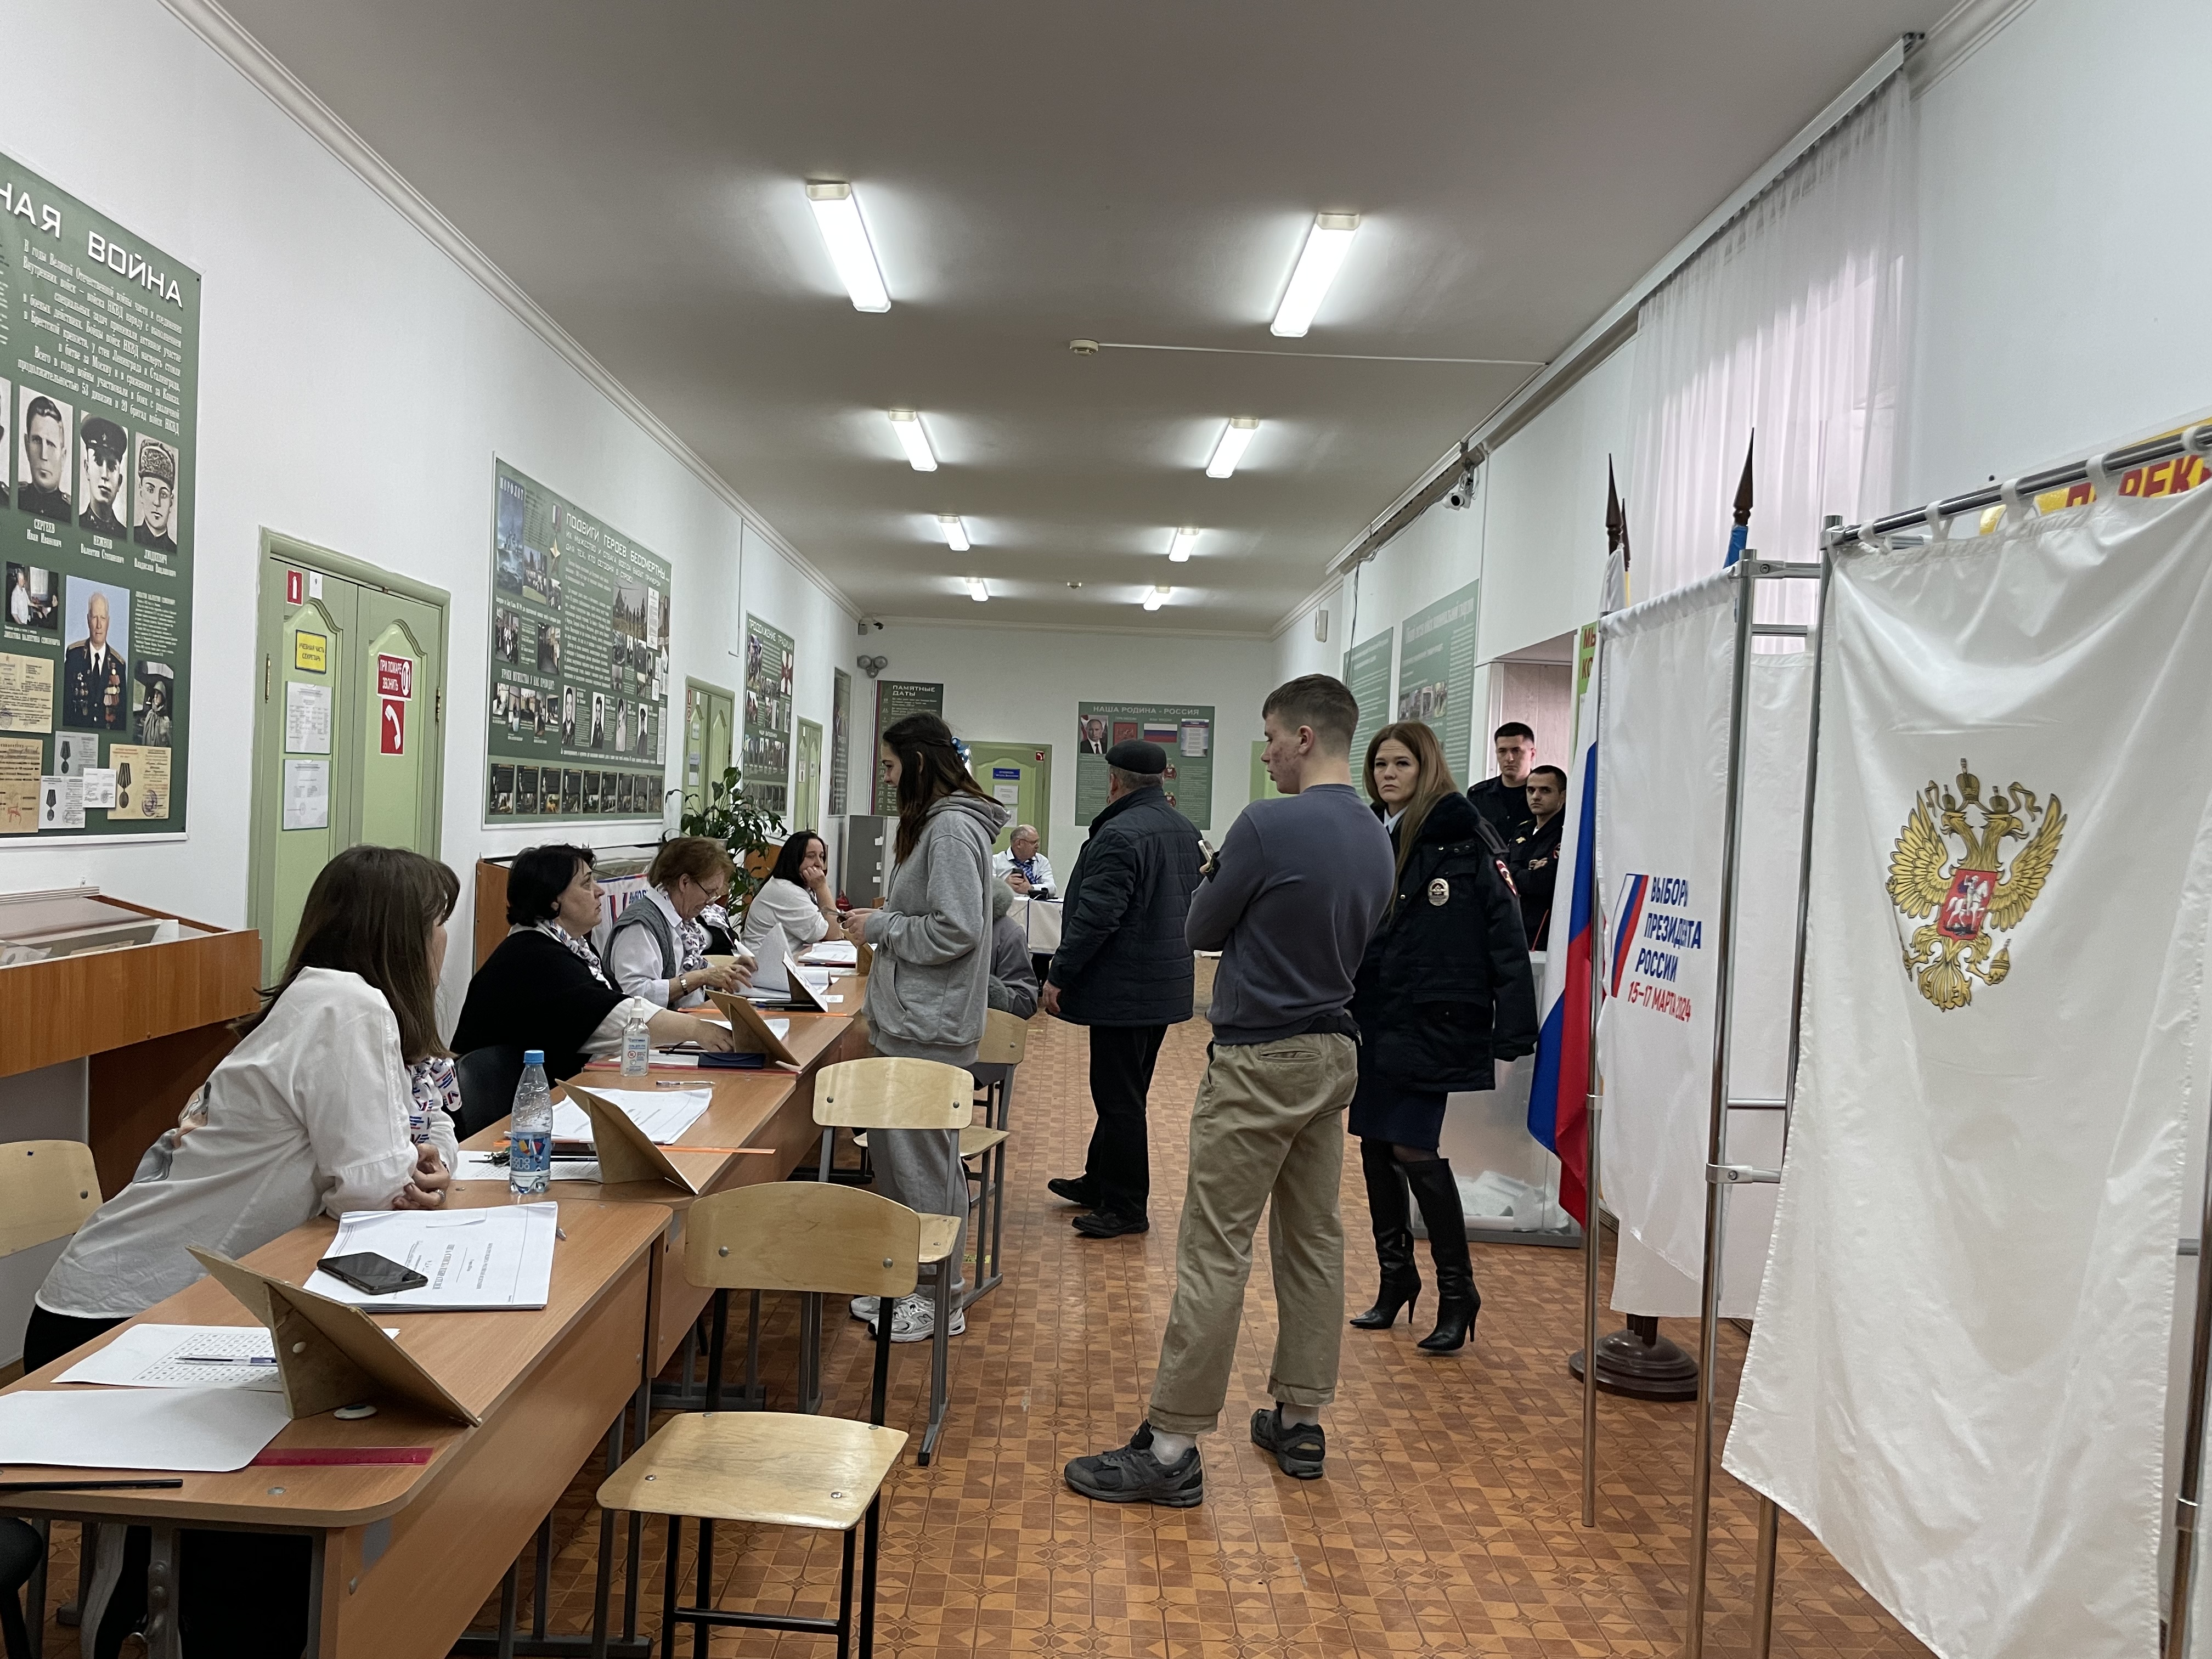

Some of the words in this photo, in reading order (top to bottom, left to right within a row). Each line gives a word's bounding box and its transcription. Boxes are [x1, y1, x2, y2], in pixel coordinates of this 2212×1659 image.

[88, 230, 183, 308] ВОЙНА
[108, 300, 123, 321] НКВД
[123, 339, 138, 359] НКВД
[82, 382, 89, 396] 53
[121, 399, 127, 412] 20
[165, 418, 179, 437] НКВД
[566, 512, 599, 542] ПОДВИГИ
[603, 534, 627, 558] ГЕРОЕВ
[574, 535, 596, 553] МУЖЕСТВО
[748, 619, 776, 642] ПРОДОЛЖЕНИЕ
[298, 642, 314, 651] УЧЕБНАЯ
[302, 653, 321, 661] СЕКРЕТАРЬ
[1635, 948, 1678, 983] РОССИИ
